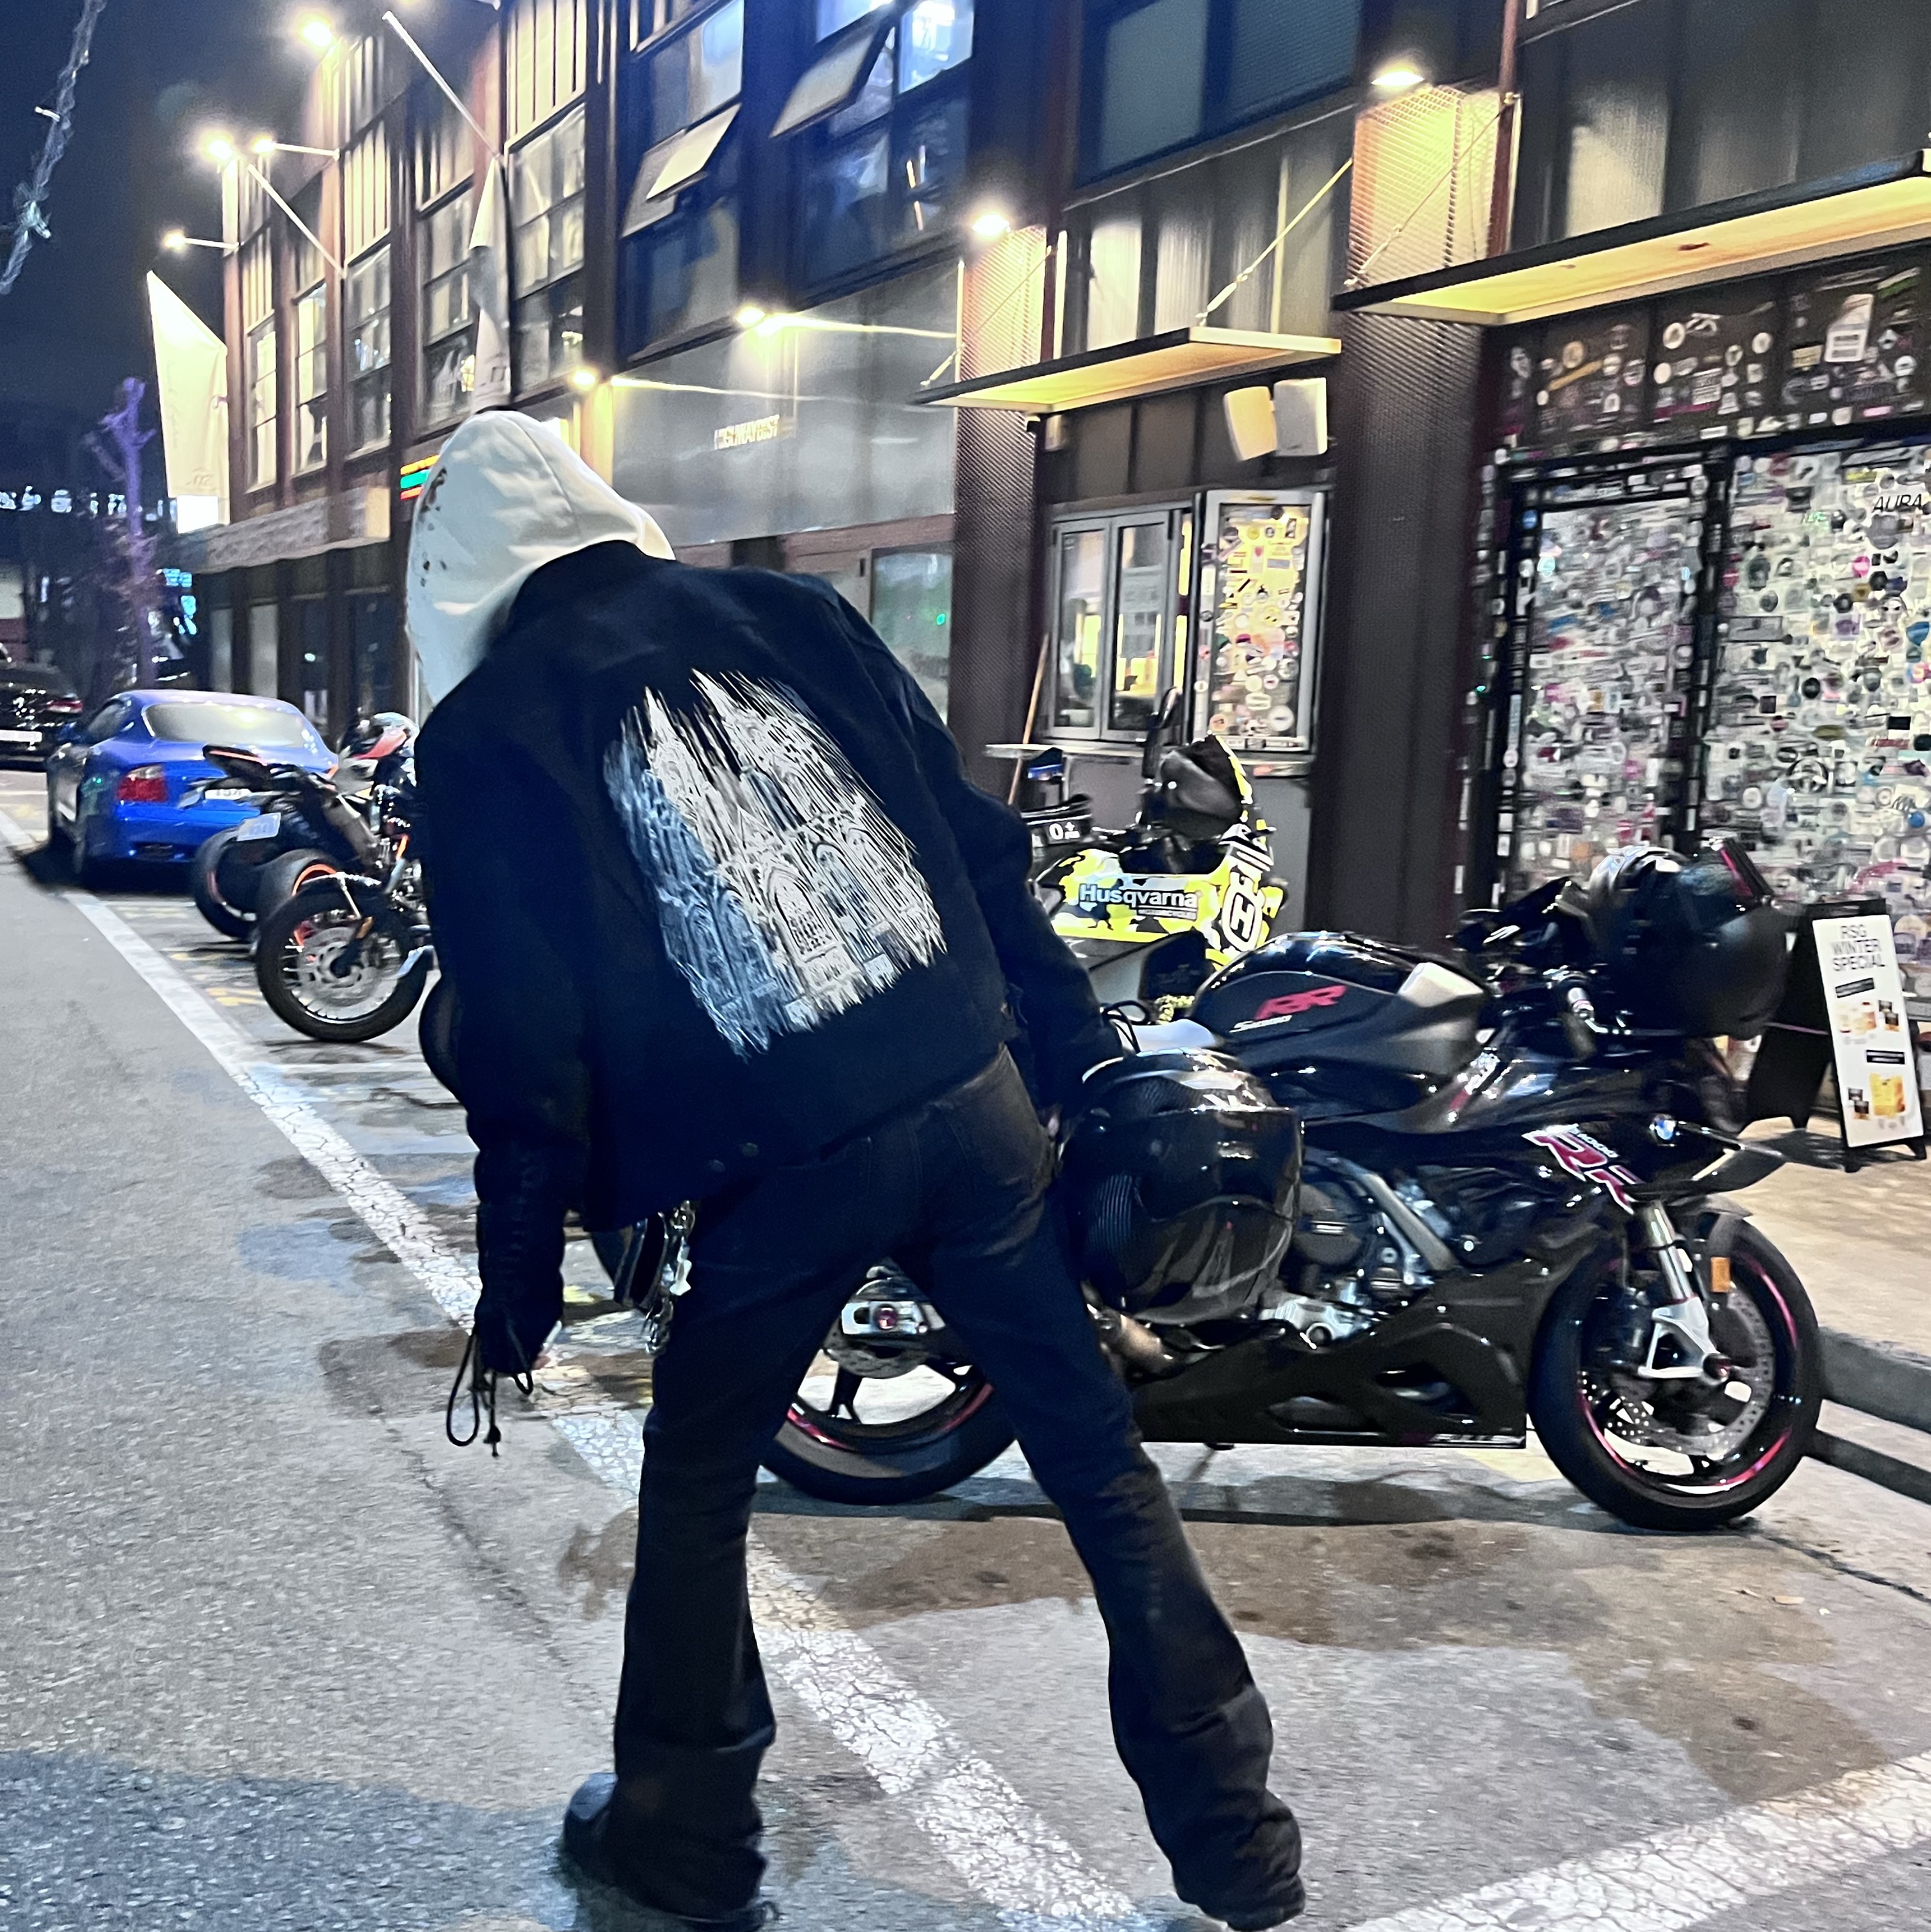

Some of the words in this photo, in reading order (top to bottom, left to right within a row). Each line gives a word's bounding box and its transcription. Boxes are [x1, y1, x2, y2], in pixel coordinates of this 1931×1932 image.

[1871, 494, 1921, 513] AURA
[1080, 884, 1198, 908] Husqvarna
[1831, 938, 1882, 955] WINTER
[1832, 954, 1886, 971] SPECIAL
